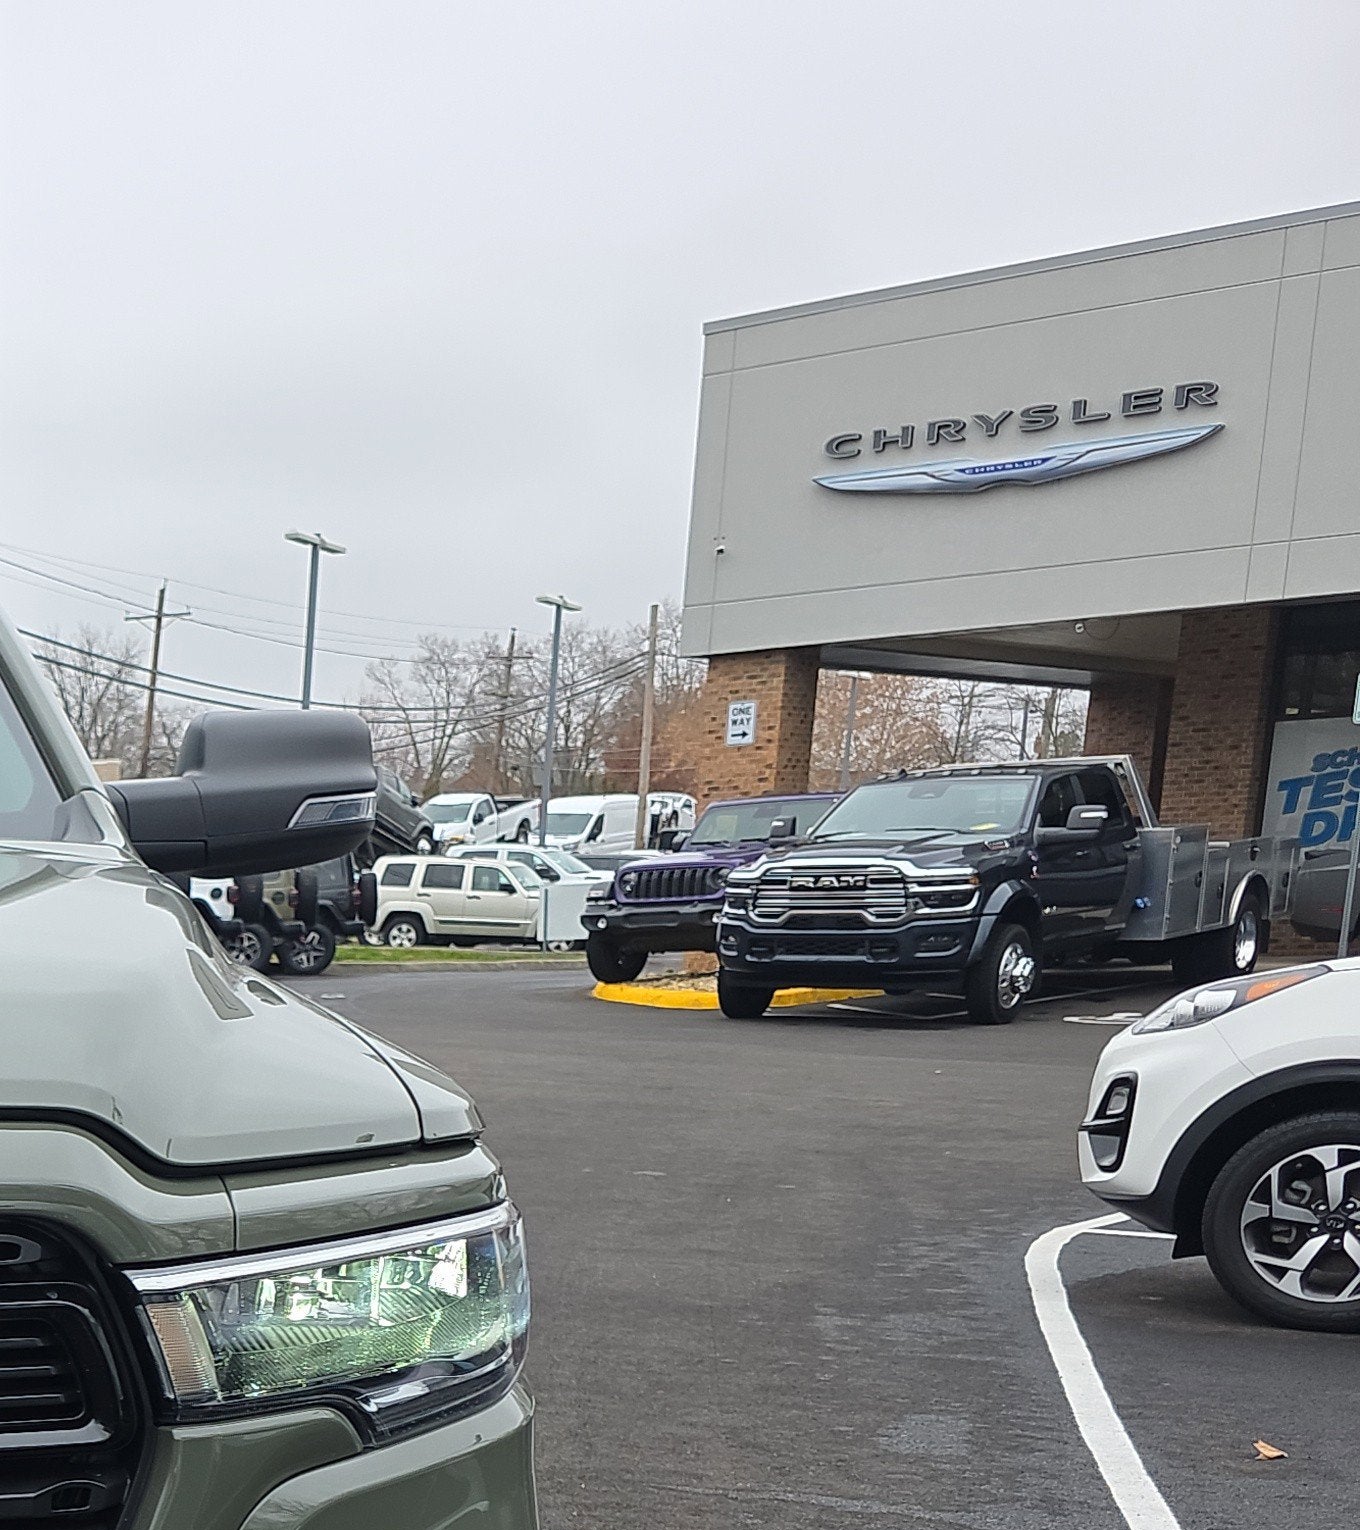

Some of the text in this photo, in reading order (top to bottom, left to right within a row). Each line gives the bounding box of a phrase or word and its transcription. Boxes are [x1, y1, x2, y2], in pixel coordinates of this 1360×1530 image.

[823, 380, 1220, 460] CHRYSLER
[731, 706, 752, 717] ONE
[730, 717, 751, 727] WAY
[790, 876, 866, 888] RAM
